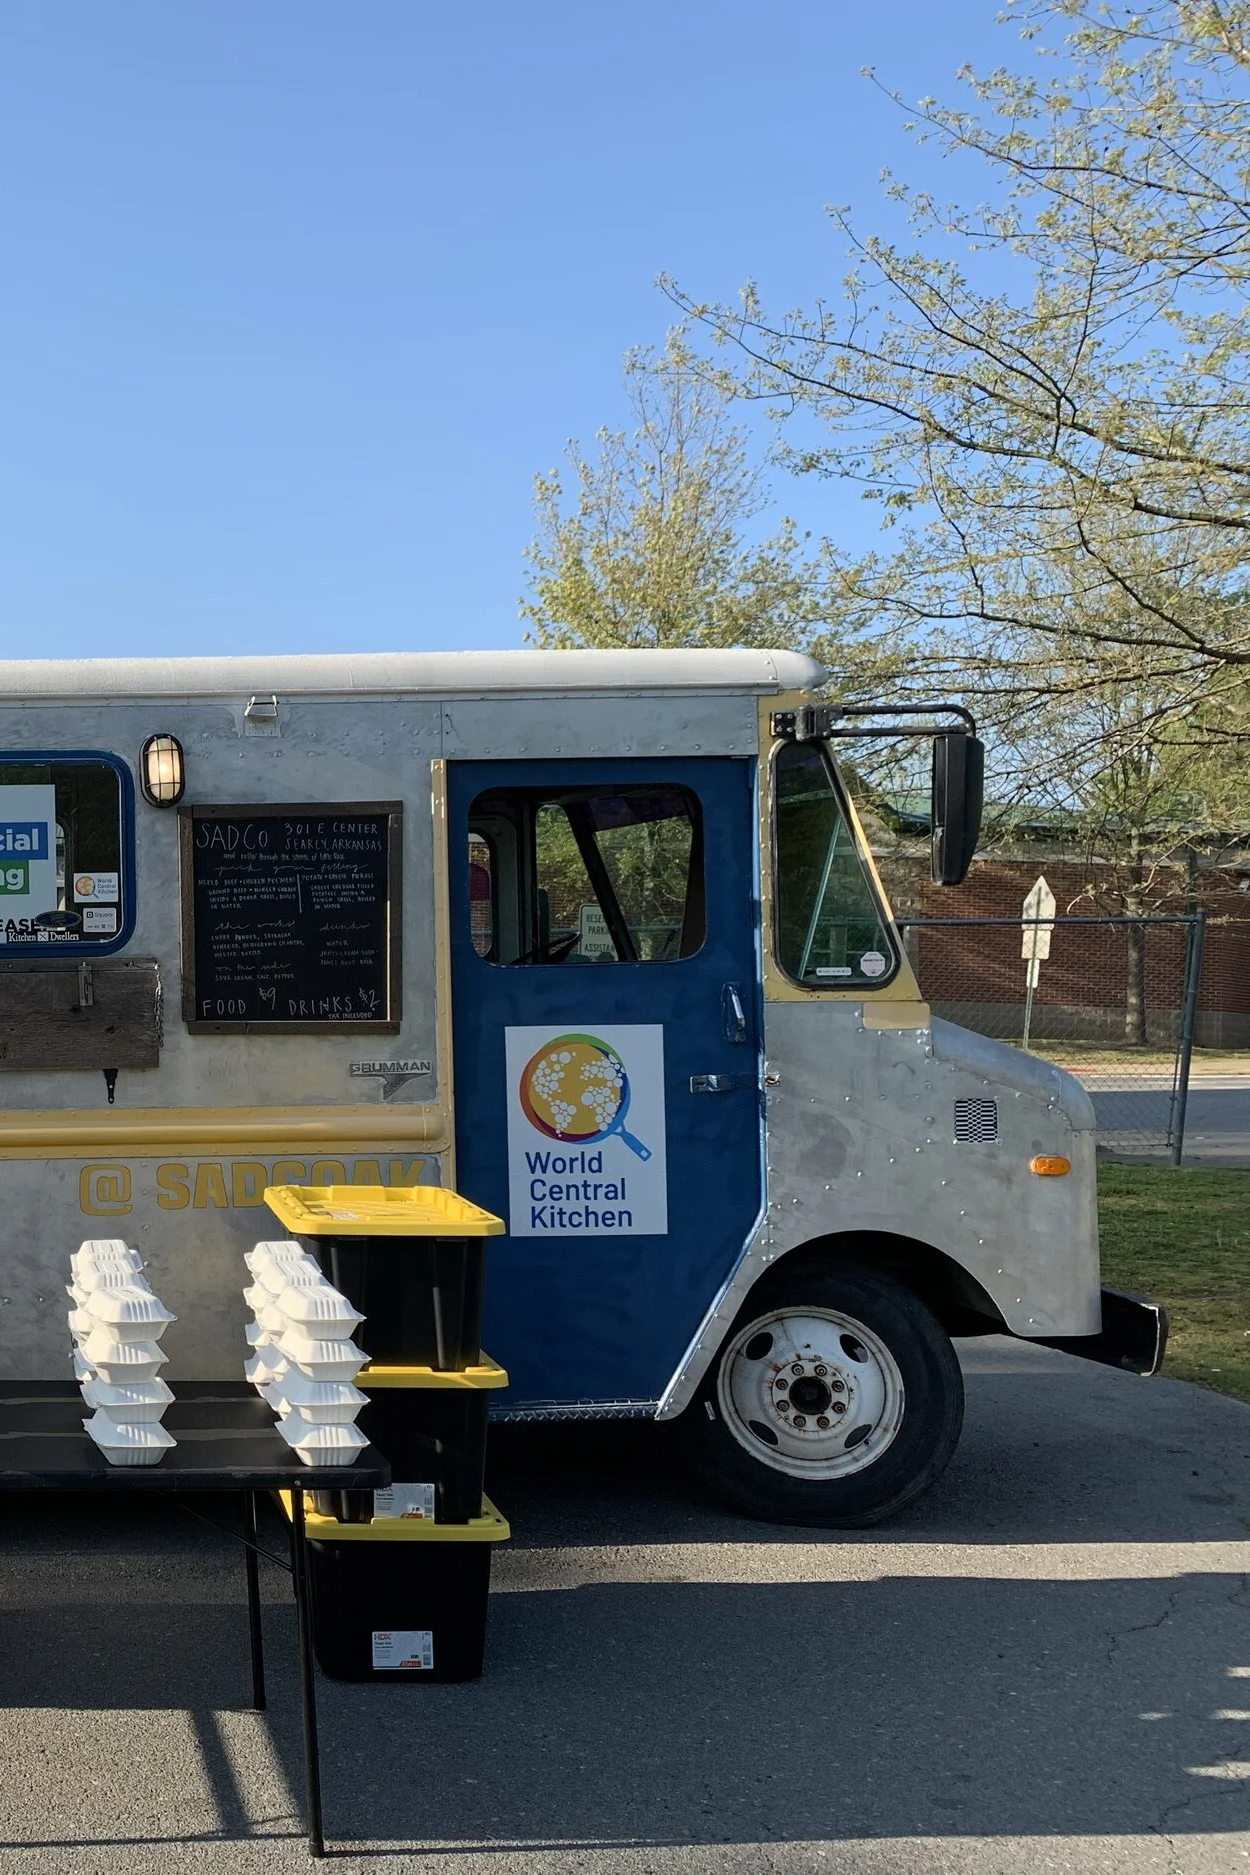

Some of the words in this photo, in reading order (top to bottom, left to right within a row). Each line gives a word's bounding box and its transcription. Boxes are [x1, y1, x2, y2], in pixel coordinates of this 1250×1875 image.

[283, 822, 310, 836] 301
[317, 822, 325, 834] E
[332, 822, 379, 834] CENTER
[331, 838, 382, 852] ARKANSAS
[8, 932, 37, 942] Kitchen
[50, 931, 80, 942] Dwellers
[326, 939, 350, 947] WATER
[203, 999, 246, 1017] FOOD
[259, 986, 276, 1011] $9
[289, 996, 353, 1016] DRINKS
[359, 986, 381, 1011] $2
[327, 1012, 340, 1020] TAX
[342, 1011, 373, 1020] INCLUDED
[349, 1060, 431, 1073] GRUMMAN
[525, 1150, 603, 1175] World
[79, 1162, 133, 1217] @
[530, 1177, 626, 1202] Central
[531, 1204, 633, 1229] Kitchen
